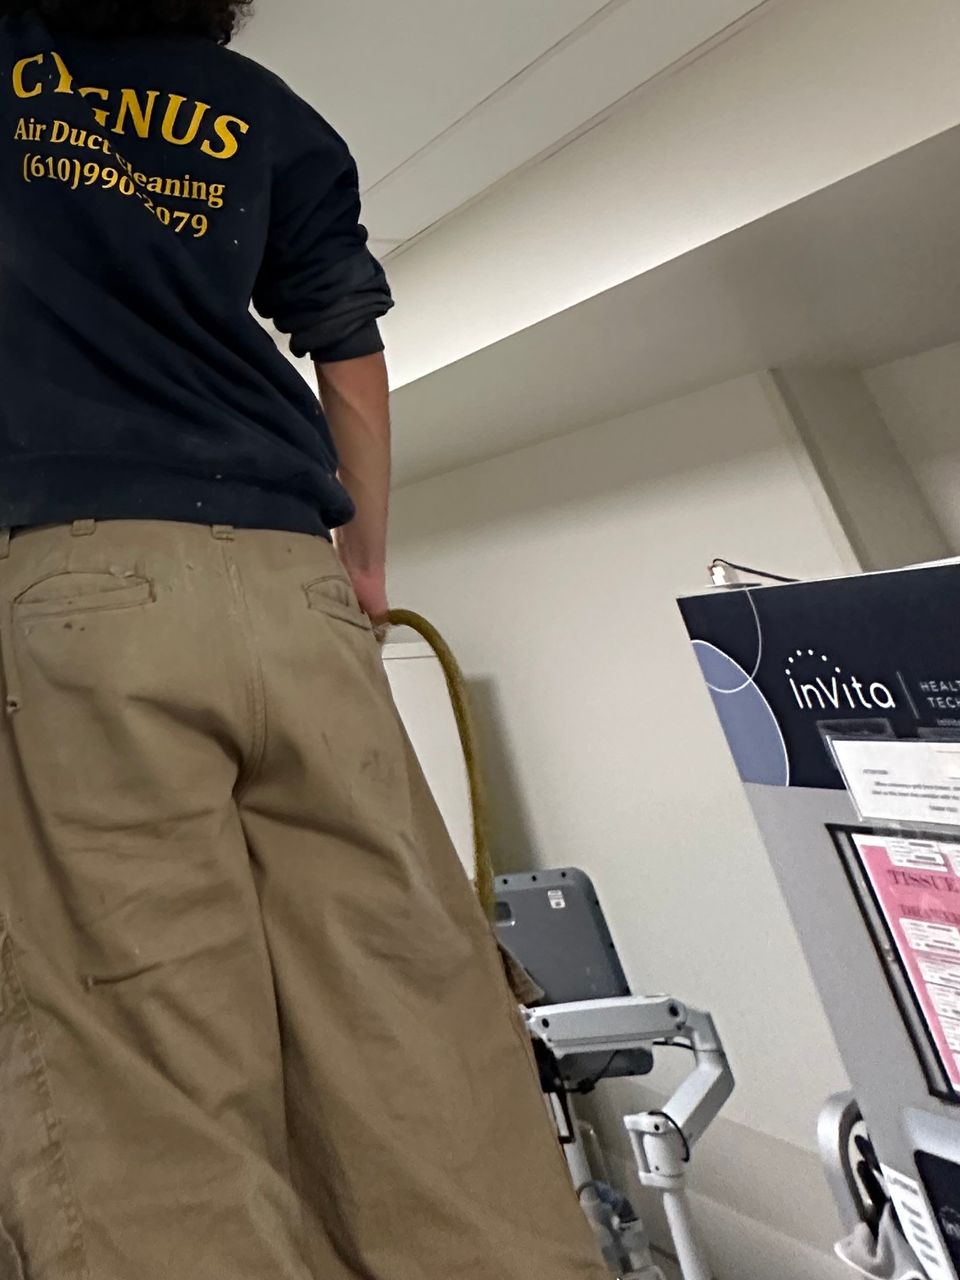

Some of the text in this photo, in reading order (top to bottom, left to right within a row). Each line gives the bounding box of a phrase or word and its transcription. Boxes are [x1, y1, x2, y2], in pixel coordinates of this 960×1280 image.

[12, 51, 249, 159] CYGNUS
[14, 117, 46, 141] Air
[50, 119, 111, 155] Duct
